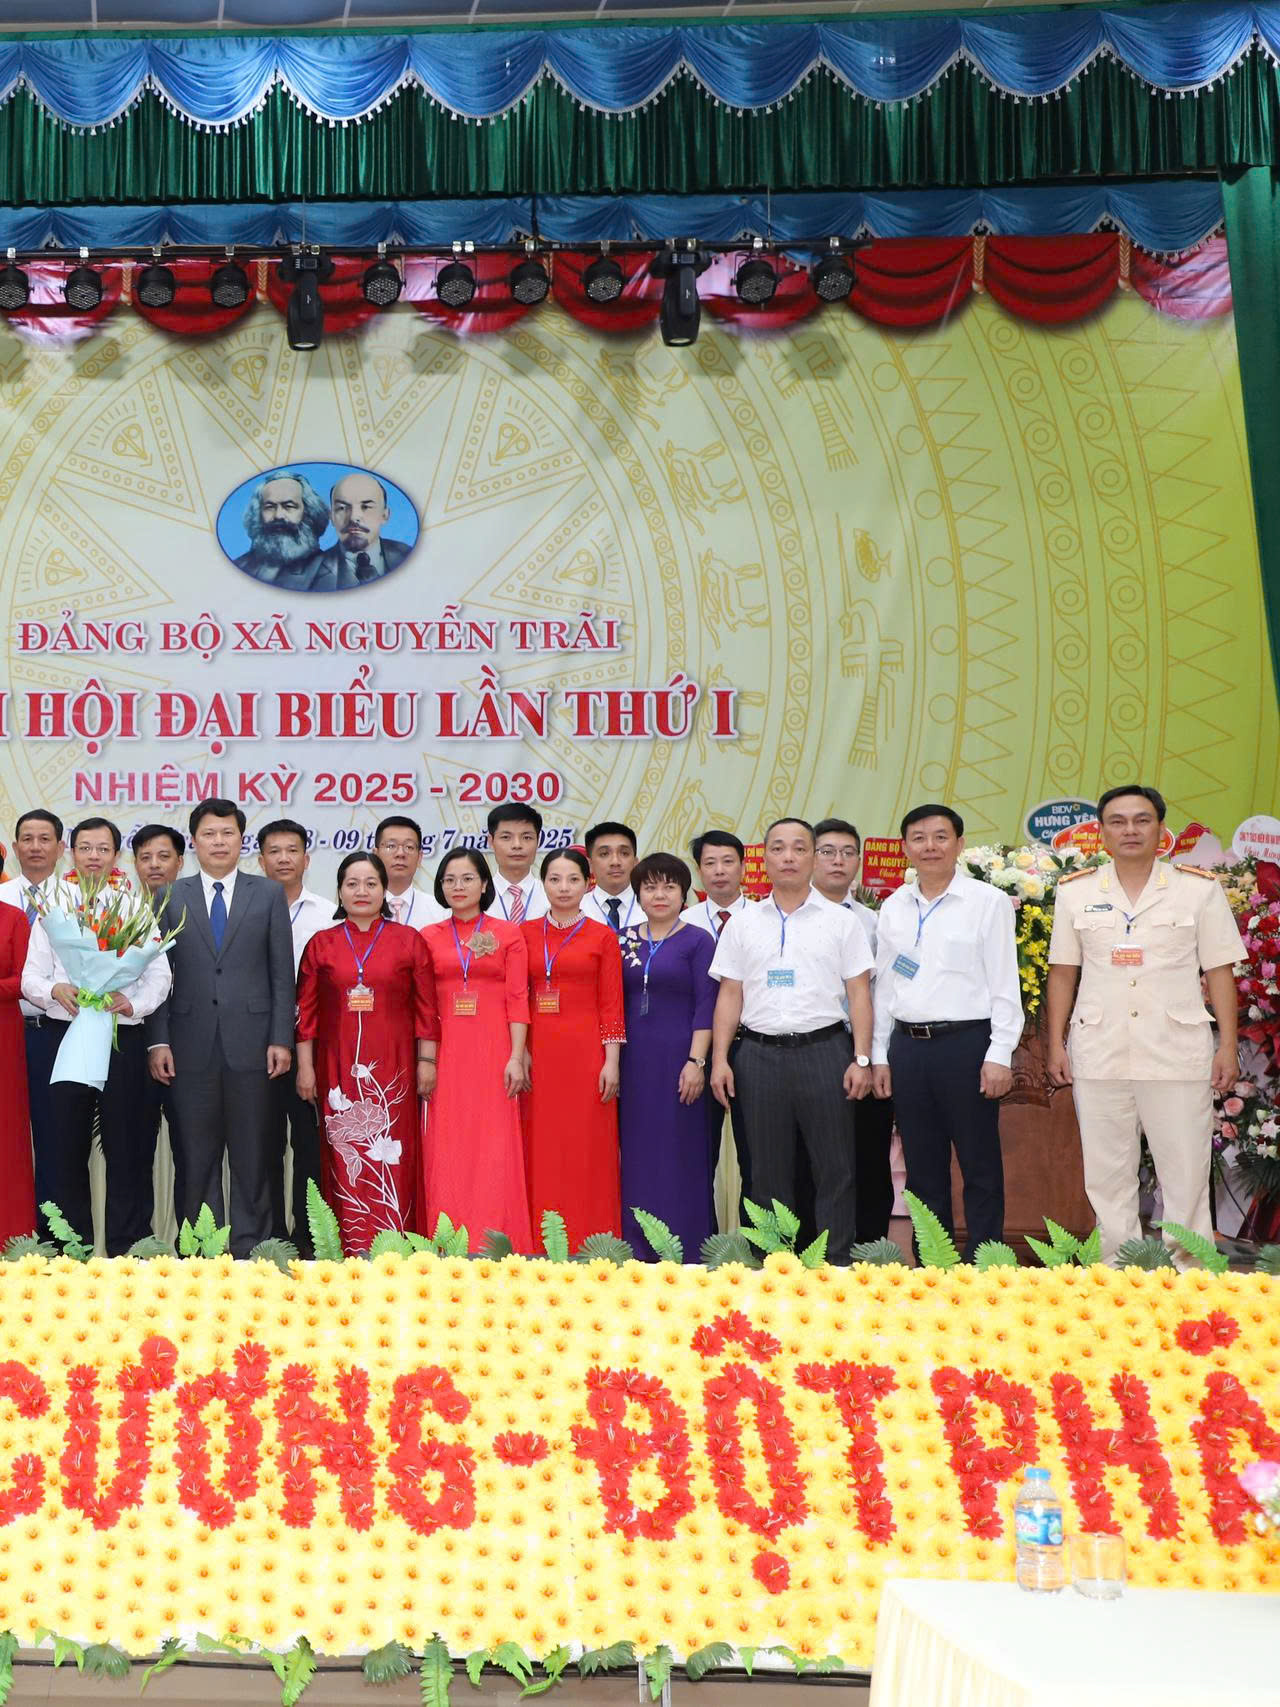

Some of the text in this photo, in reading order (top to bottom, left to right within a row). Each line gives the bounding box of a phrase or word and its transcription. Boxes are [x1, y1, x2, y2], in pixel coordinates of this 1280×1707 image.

[18, 604, 619, 660] ĐẢNG BỘ XÃ NGUYỄN TRÃI
[28, 679, 135, 753] HỘI
[158, 692, 256, 754] ĐẠI
[274, 664, 417, 738] BIỂU
[435, 664, 549, 738] LẦN
[564, 674, 698, 738] THỨ
[712, 690, 735, 738] I
[75, 764, 219, 809] NHIỆM
[238, 763, 298, 802] KỲ
[314, 773, 414, 803] 2025
[460, 771, 560, 803] 2030
[1034, 815, 1071, 827] HƯNG
[1051, 805, 1073, 815] BIDV
[333, 830, 360, 850] 09
[462, 829, 488, 849] nă
[537, 828, 573, 849] 025
[569, 1308, 900, 1595] ĐỘT
